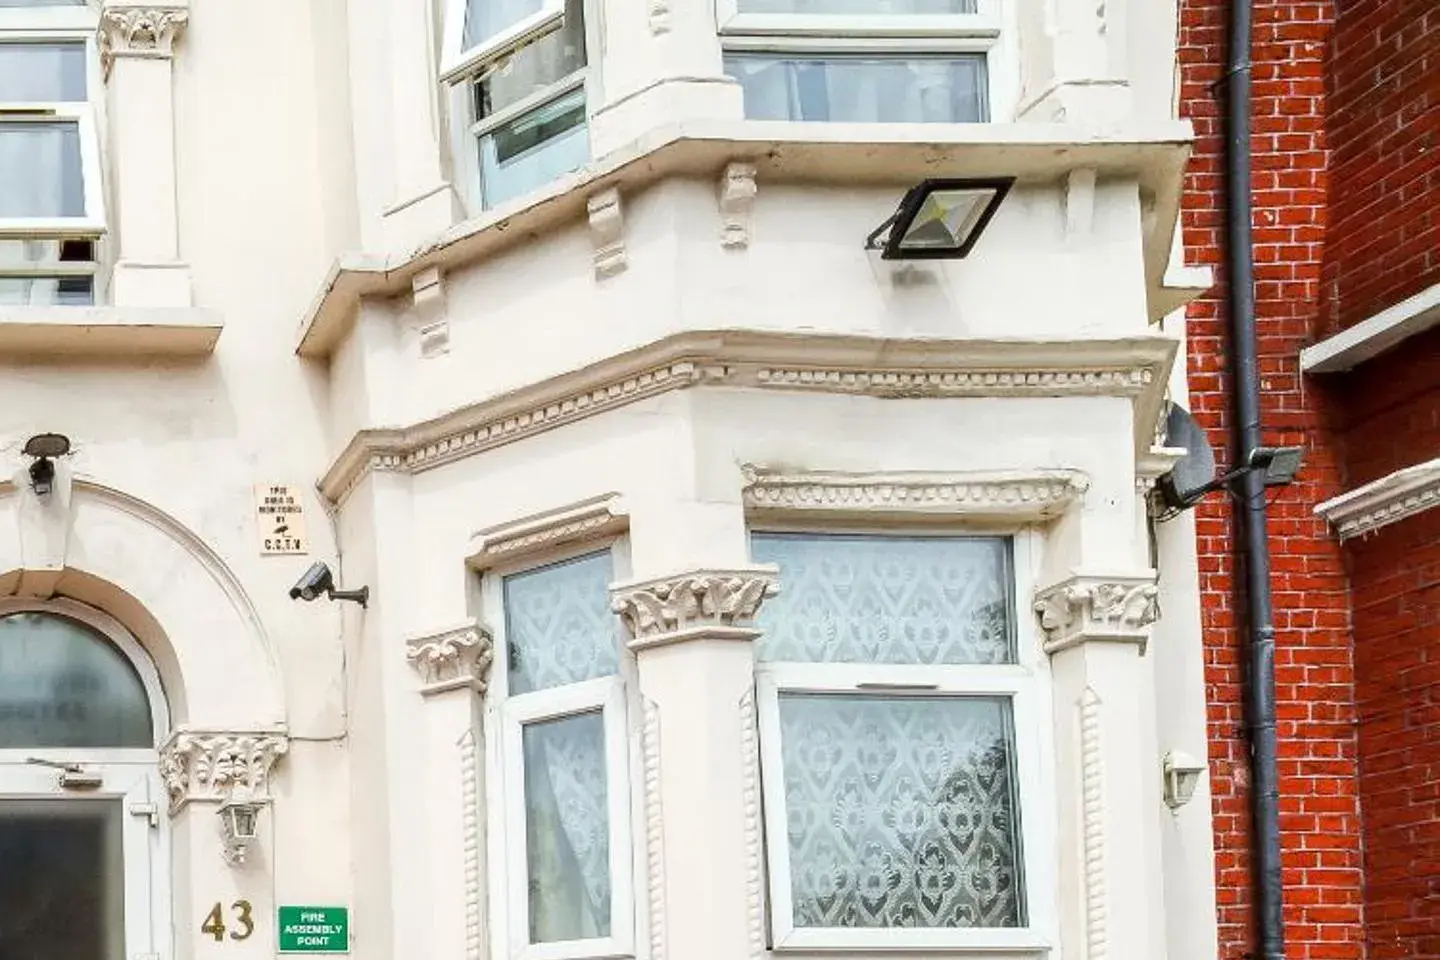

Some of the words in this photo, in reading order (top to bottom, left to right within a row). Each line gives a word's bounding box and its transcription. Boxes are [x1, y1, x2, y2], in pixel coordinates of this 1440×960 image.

[201, 900, 254, 942] 43
[300, 913, 325, 922] FIRE
[284, 925, 343, 934] ASSEMBLY
[297, 937, 330, 946] POINT
